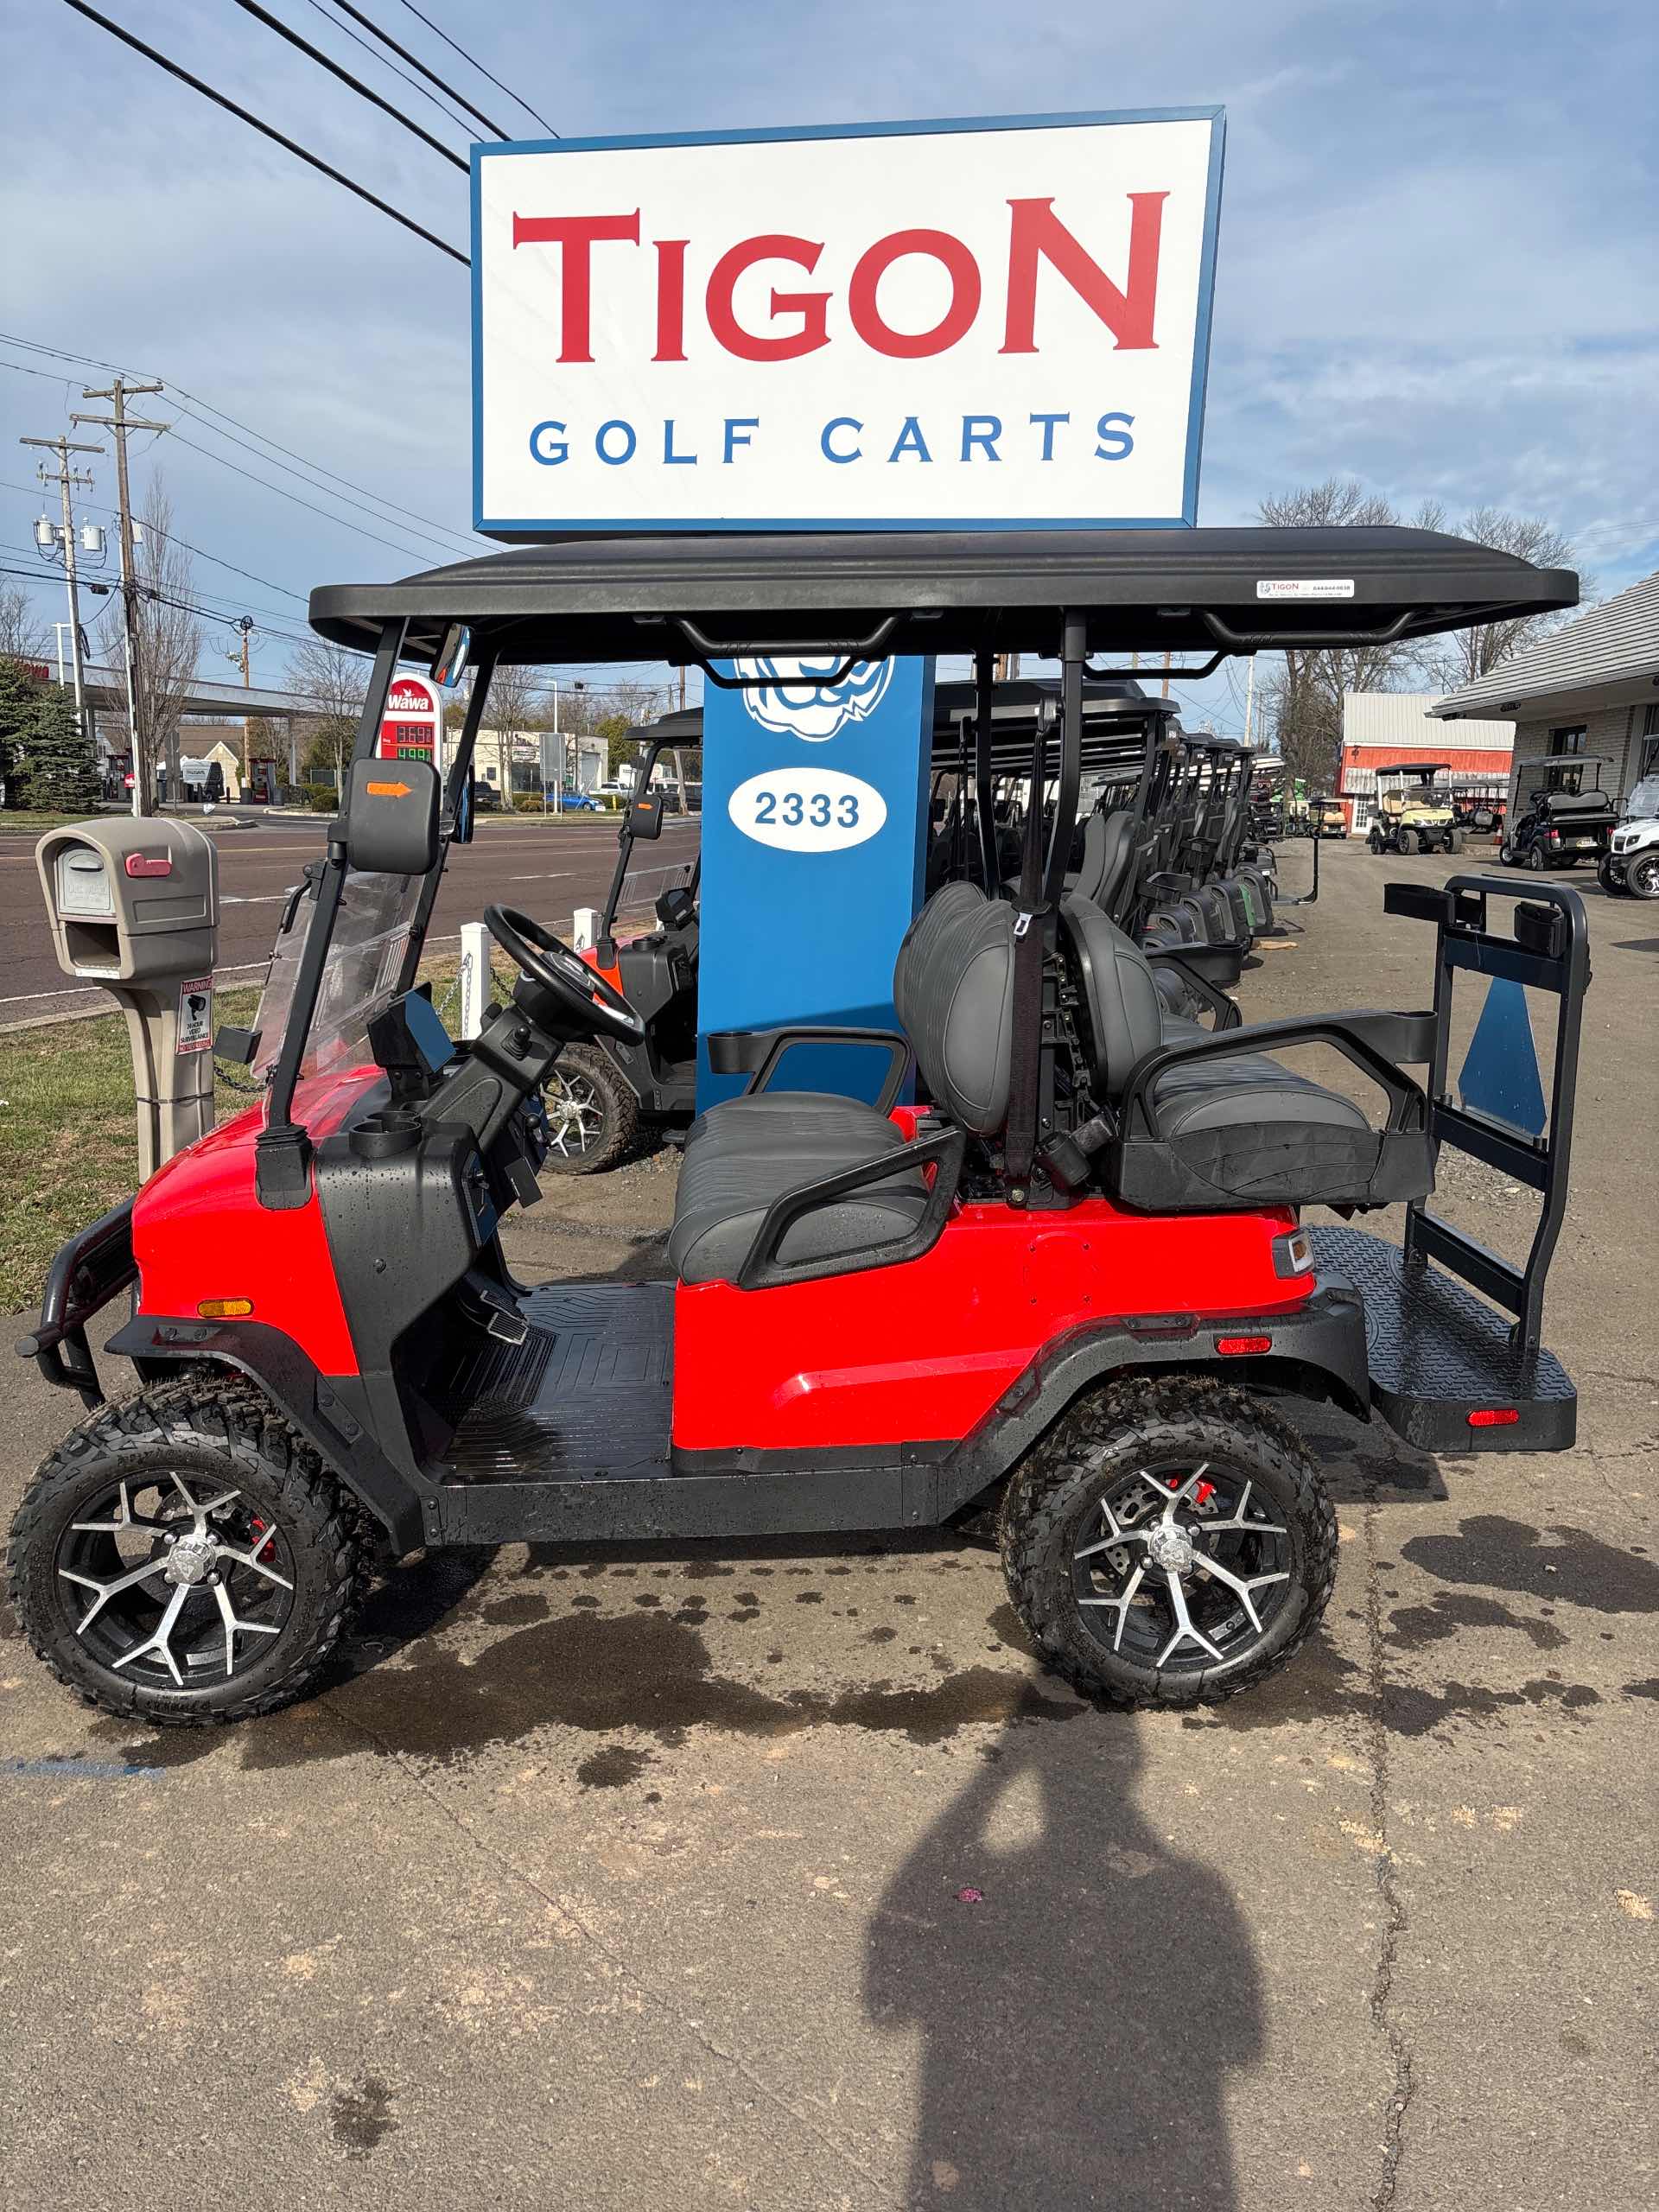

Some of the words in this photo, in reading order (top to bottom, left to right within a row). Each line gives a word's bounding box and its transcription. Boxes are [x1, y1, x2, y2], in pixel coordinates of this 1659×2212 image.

[513, 191, 1171, 363] TIGON
[529, 416, 760, 466] GOLF
[821, 411, 1135, 464] CARTS
[1271, 582, 1299, 591] TIGON
[388, 694, 429, 710] Wawa
[754, 791, 860, 829] 2333
[183, 979, 212, 993] WARNING
